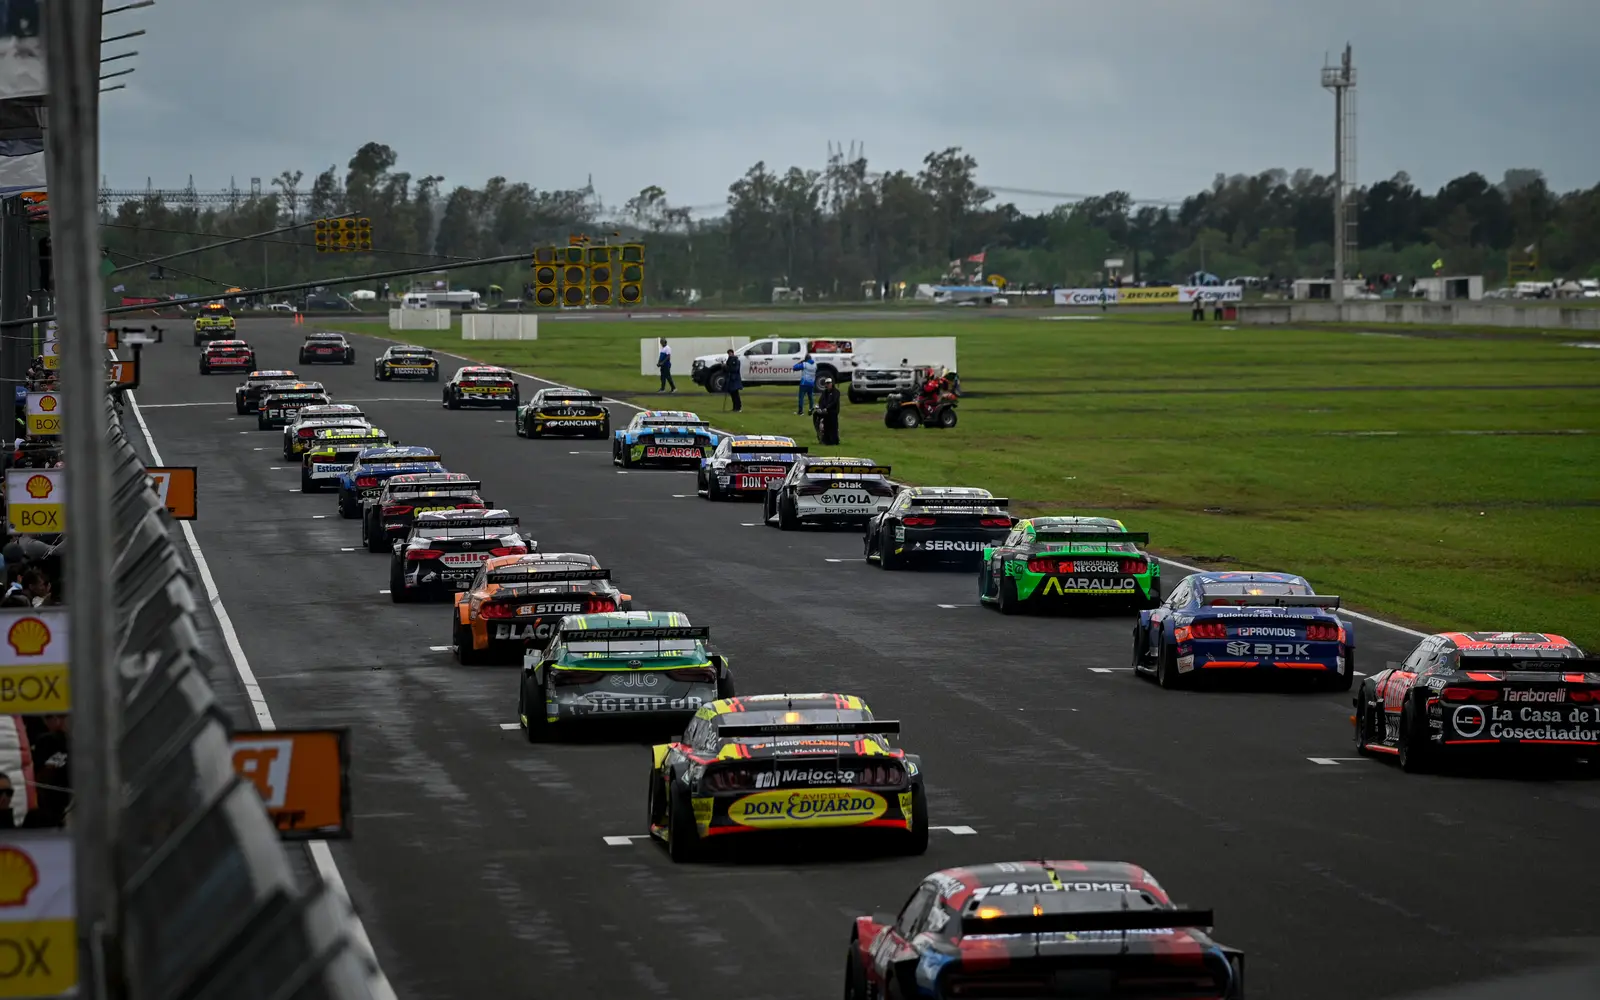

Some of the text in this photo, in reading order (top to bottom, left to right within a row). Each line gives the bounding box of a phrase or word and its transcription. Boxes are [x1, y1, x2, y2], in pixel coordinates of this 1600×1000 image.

[1127, 290, 1179, 299] DUNLOP
[748, 366, 795, 374] Montanar
[268, 409, 300, 418] FIS
[36, 419, 61, 430] BOX
[657, 448, 702, 458] ALARCIA
[742, 475, 761, 488] DON
[21, 510, 57, 526] BOX
[925, 540, 992, 552] SERQUIM
[1073, 560, 1119, 568] PREMOLDEADOS
[1073, 565, 1119, 573] NECOCHEA
[553, 570, 607, 579] PARTS
[1064, 577, 1135, 589] ARAUJO
[536, 603, 581, 613] STORE
[495, 624, 556, 640] BLAC
[640, 627, 704, 637] PARTS
[1250, 628, 1296, 637] PROVIDUS
[1254, 643, 1310, 656] BDK
[1, 676, 60, 702] BOX
[1502, 687, 1567, 703] Taraborelli
[1491, 706, 1513, 721] La
[1520, 707, 1561, 722] Casa
[1568, 708, 1589, 723] de
[1490, 722, 1600, 741] Cosechador
[782, 768, 855, 782] Maiocco
[744, 801, 784, 816] DON
[1021, 882, 1141, 893] MOTOMEL
